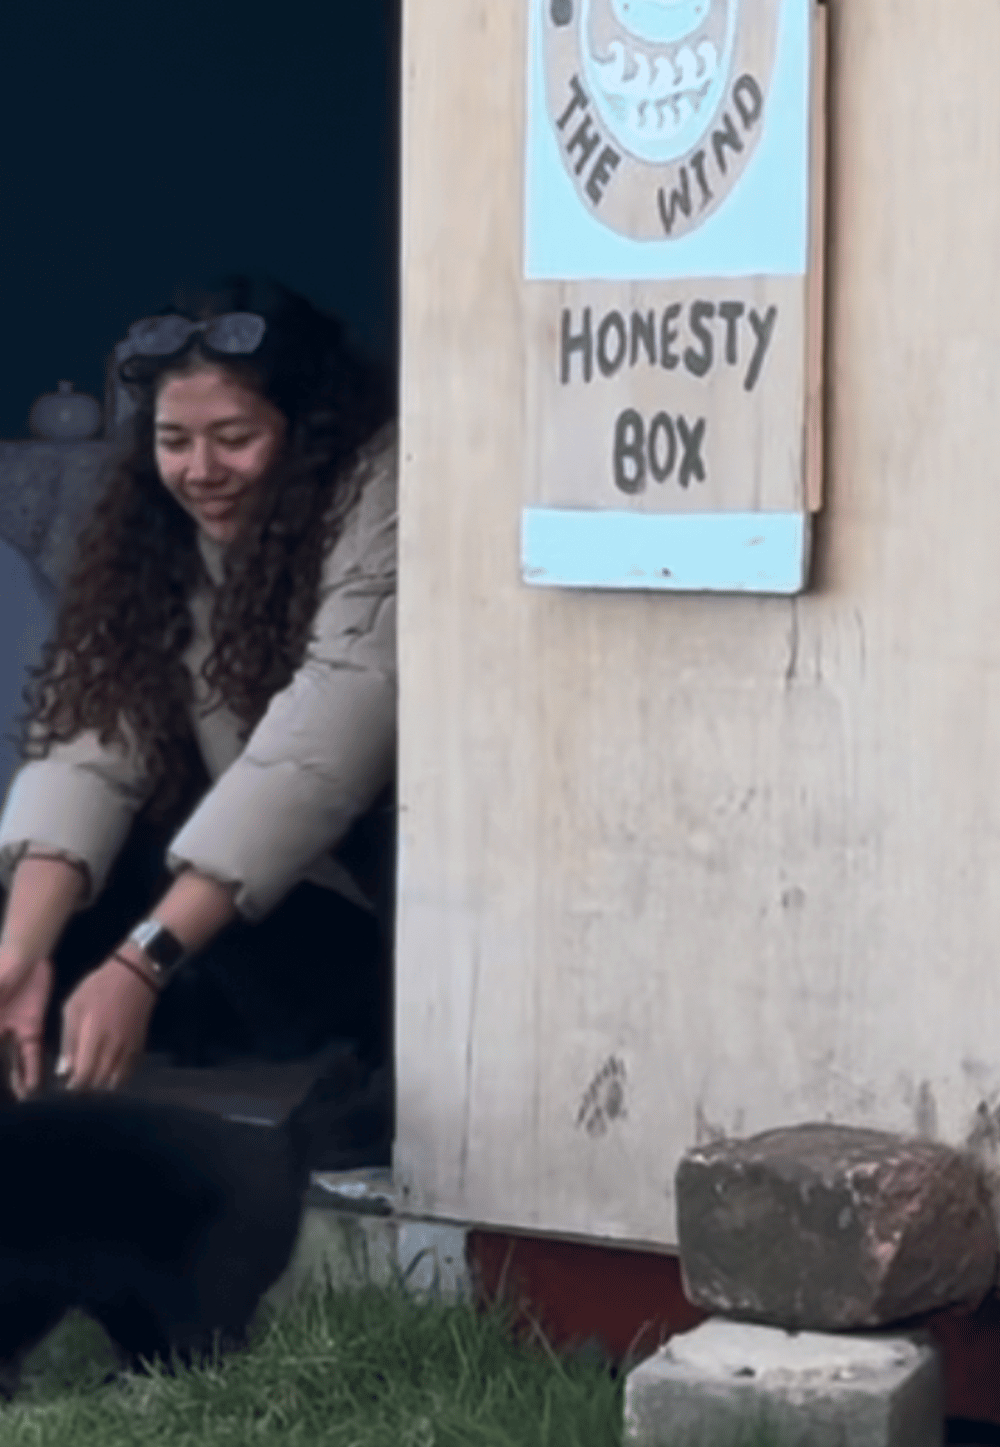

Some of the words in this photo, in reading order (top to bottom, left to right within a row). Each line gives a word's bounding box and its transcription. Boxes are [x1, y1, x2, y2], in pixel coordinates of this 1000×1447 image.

[554, 74, 621, 207] THE
[656, 73, 763, 235] WIND
[560, 299, 778, 393] HONESTY
[613, 407, 706, 495] BOX
